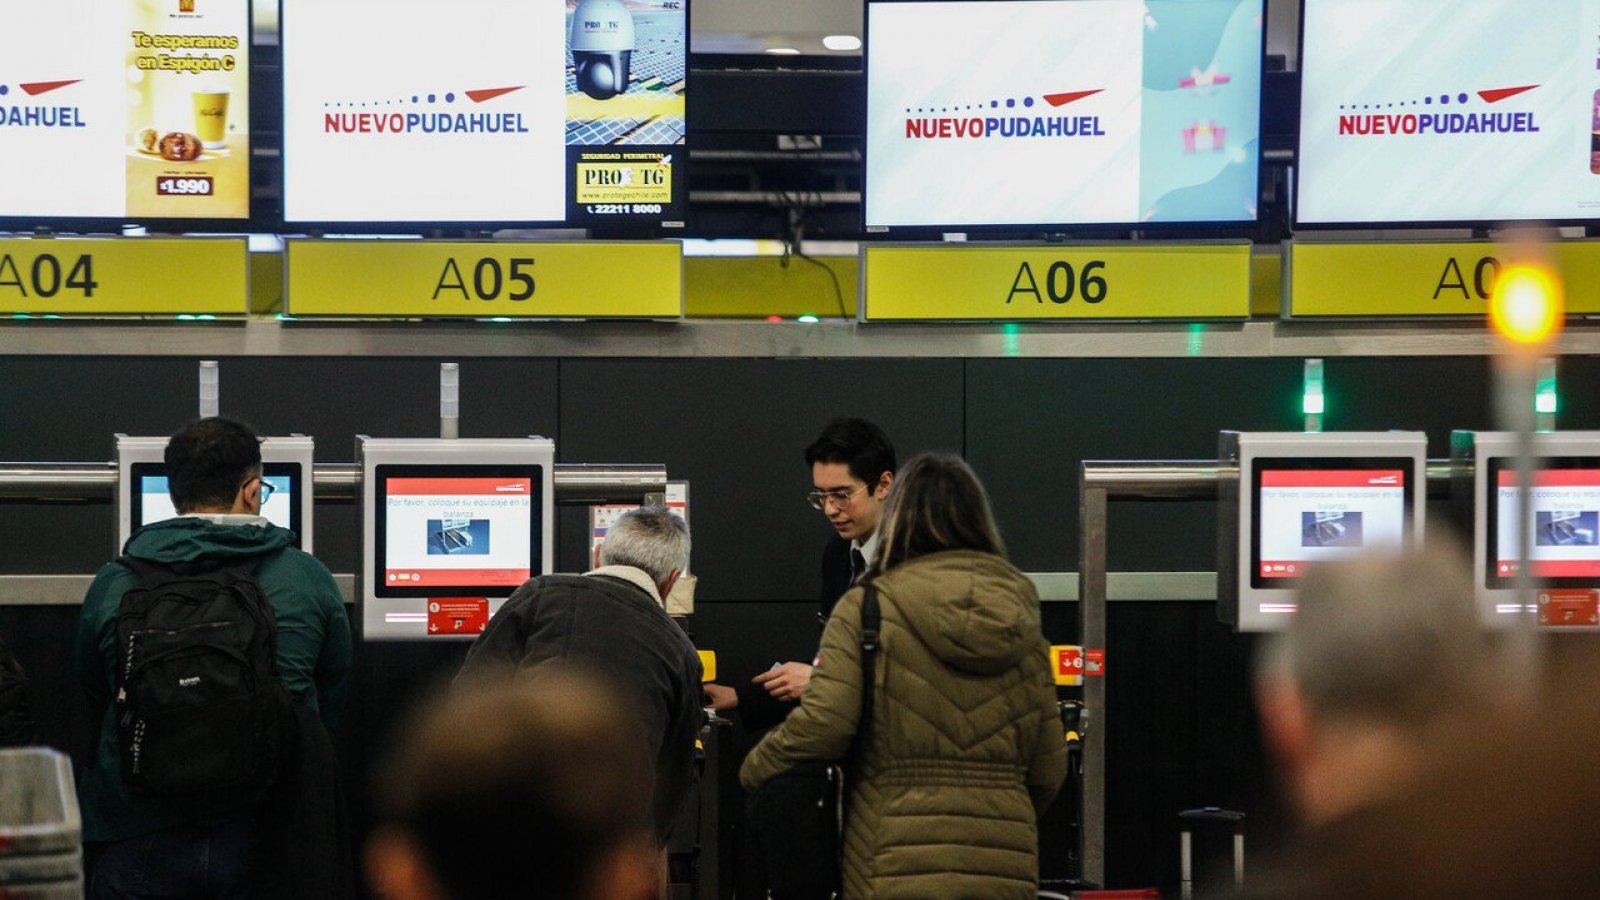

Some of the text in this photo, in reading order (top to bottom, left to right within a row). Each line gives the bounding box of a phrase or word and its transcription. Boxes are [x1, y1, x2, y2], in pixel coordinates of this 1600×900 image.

[131, 31, 239, 52] Te esperamos
[136, 53, 235, 74] en Espigón C
[0, 106, 86, 127] AHUEL
[324, 113, 529, 133] NUEVOPUDAHUEL
[1339, 112, 1540, 135] NUEVOPUDAHUEL
[905, 116, 1106, 139] NUEVOPUDAHUEL
[160, 179, 210, 194] $1.990
[585, 169, 664, 185] PRO TG
[594, 204, 662, 214] 22211 8000
[0, 254, 99, 298] A04
[432, 257, 537, 301] A05
[1005, 260, 1108, 305] A06
[1433, 256, 1503, 300] A0
[387, 498, 402, 506] Por
[428, 498, 460, 509] coloque
[473, 498, 508, 509] equipaje
[523, 498, 529, 506] la
[443, 510, 474, 518] balanza
